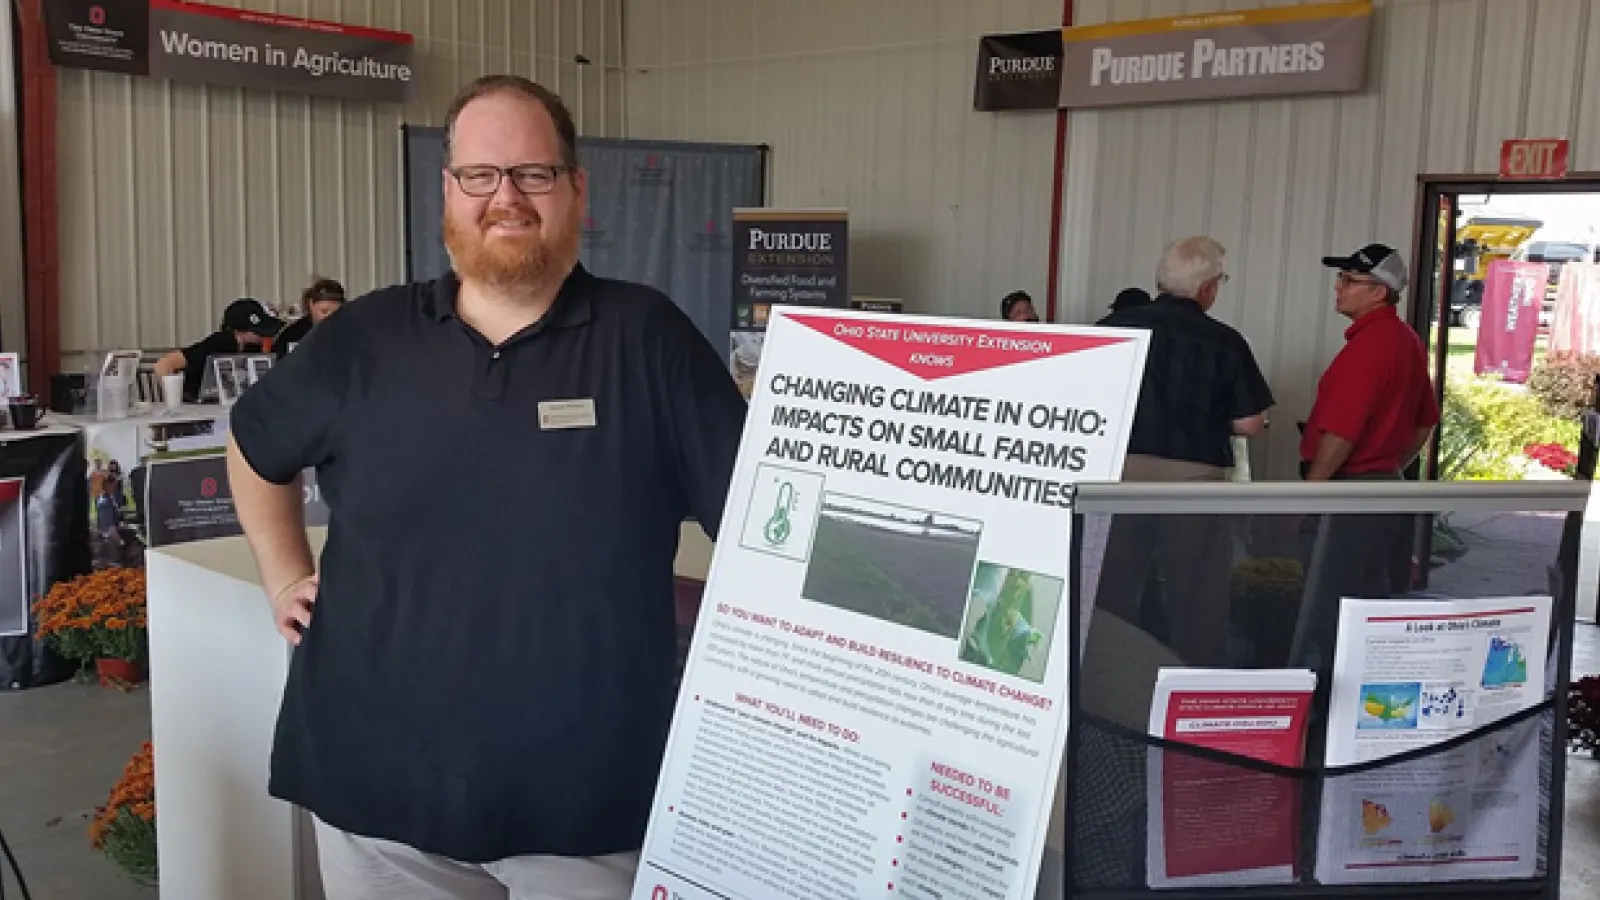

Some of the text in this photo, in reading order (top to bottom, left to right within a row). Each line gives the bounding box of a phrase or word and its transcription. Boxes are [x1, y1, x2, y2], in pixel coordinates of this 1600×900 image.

[160, 29, 259, 63] Women
[265, 43, 288, 67] in
[291, 46, 412, 81] Agriculture
[988, 56, 1055, 73] PURDUE
[1089, 38, 1325, 86] PURDUE PARTNERS
[1509, 143, 1557, 175] EXIT
[748, 227, 832, 251] PURDUE
[746, 253, 835, 266] EXTENSION
[833, 322, 1053, 353] OHIO STATE UNIVERSITY EXTENSION
[908, 352, 955, 368] KNOWS
[770, 372, 1107, 437] CHANGING CLIMATE IN OHIO:
[770, 404, 1088, 473] IMPACTS ON SMALL FARMS
[764, 436, 1074, 509] AND RURAL COMMUNITIES
[750, 612, 778, 628] WANT
[778, 619, 793, 633] TO
[792, 624, 824, 641] ADAPT
[825, 633, 848, 648] AND
[936, 665, 951, 679] TO
[952, 671, 998, 694] CLIMATE
[930, 761, 976, 787] NEEDED
[978, 777, 993, 794] TO
